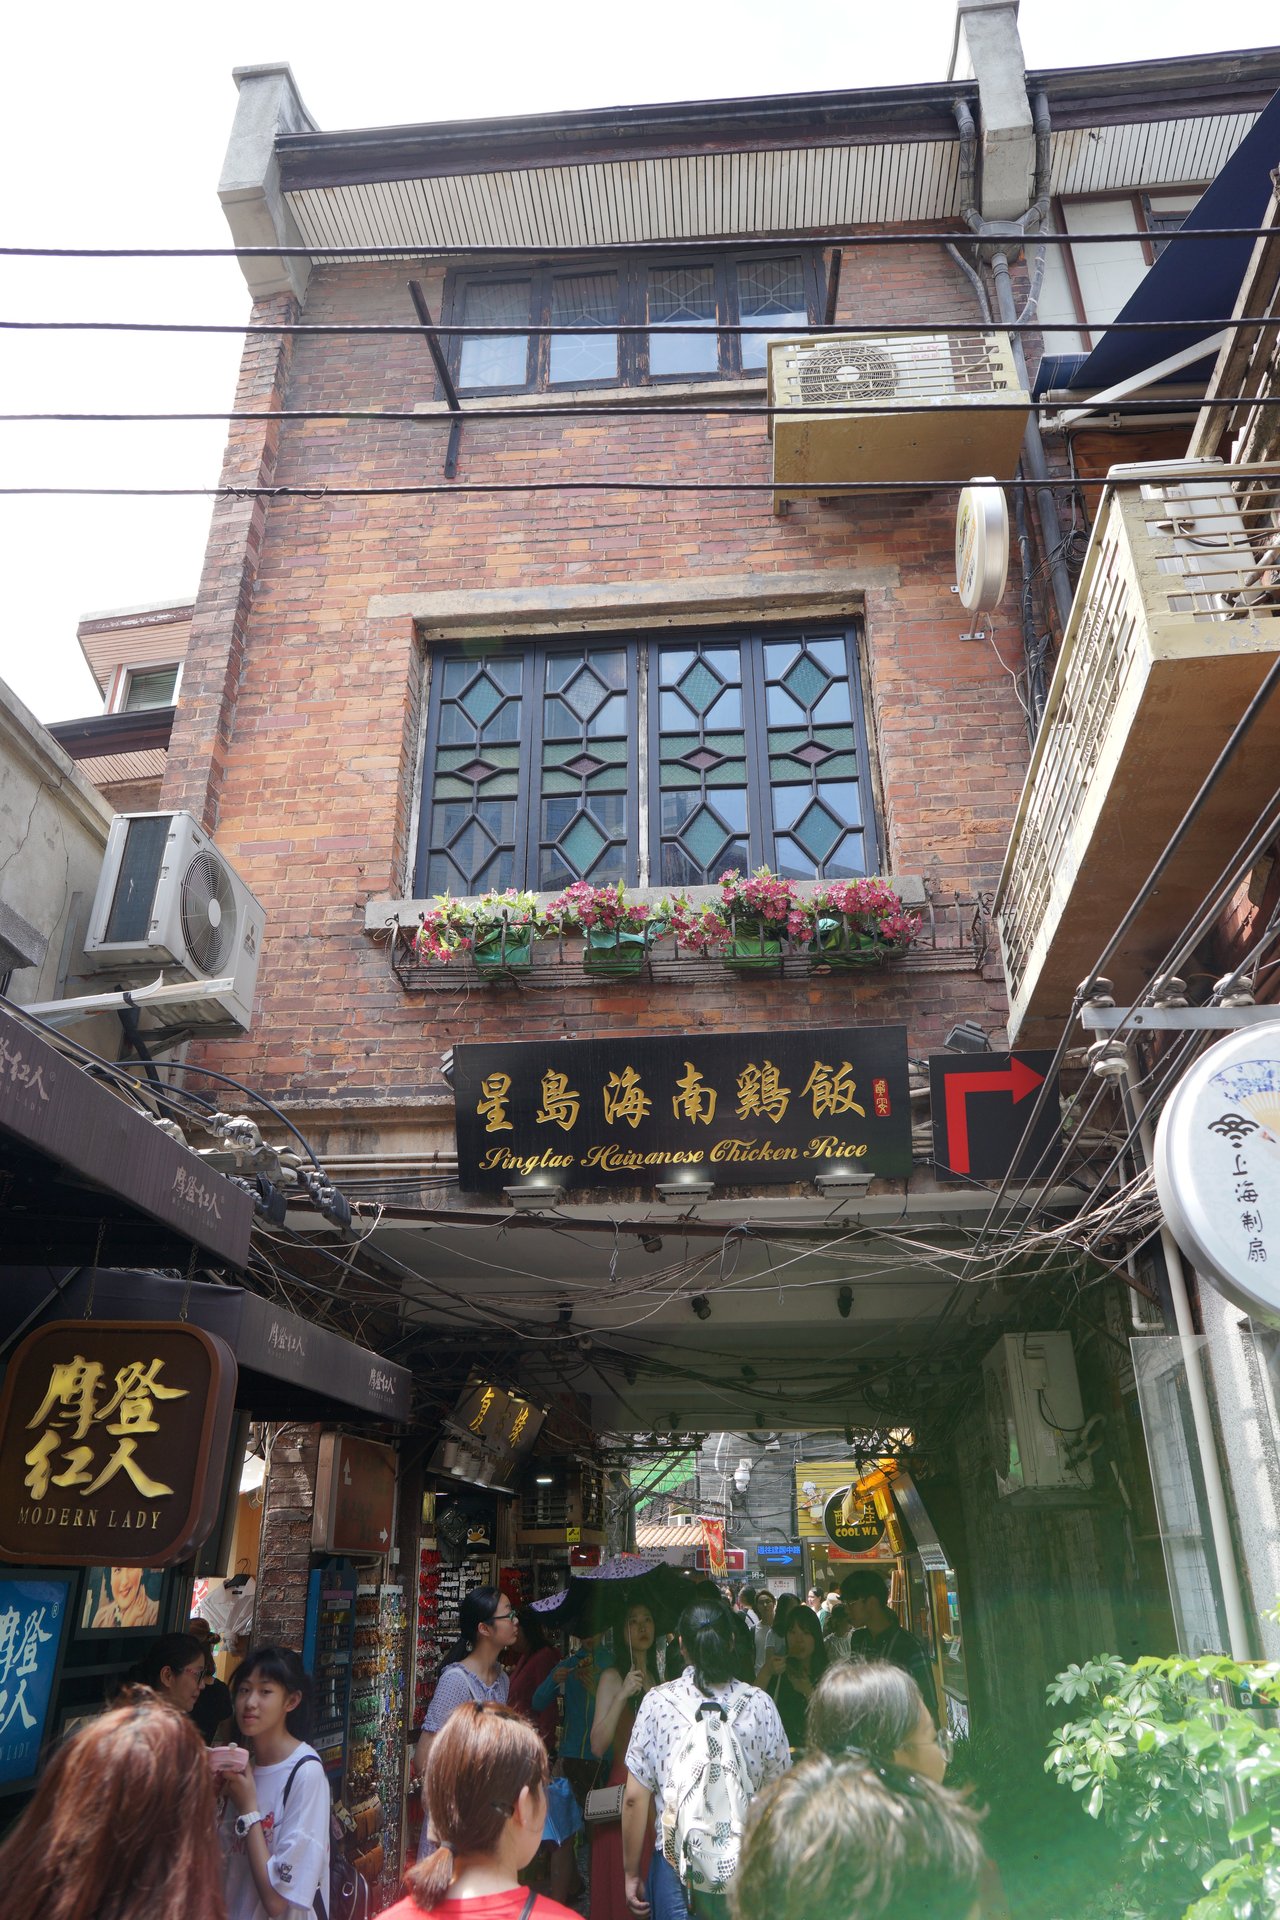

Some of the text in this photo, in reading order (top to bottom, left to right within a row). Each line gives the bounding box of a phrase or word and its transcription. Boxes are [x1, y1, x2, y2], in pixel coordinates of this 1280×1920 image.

[478, 1135, 868, 1176] Singtao Hainanese Chicken Rice
[1231, 1153, 1268, 1263] 上海制扇
[25, 1354, 190, 1440] 摩登
[17, 1505, 162, 1530] MODERN LADY
[835, 1526, 879, 1537] COOL WA
